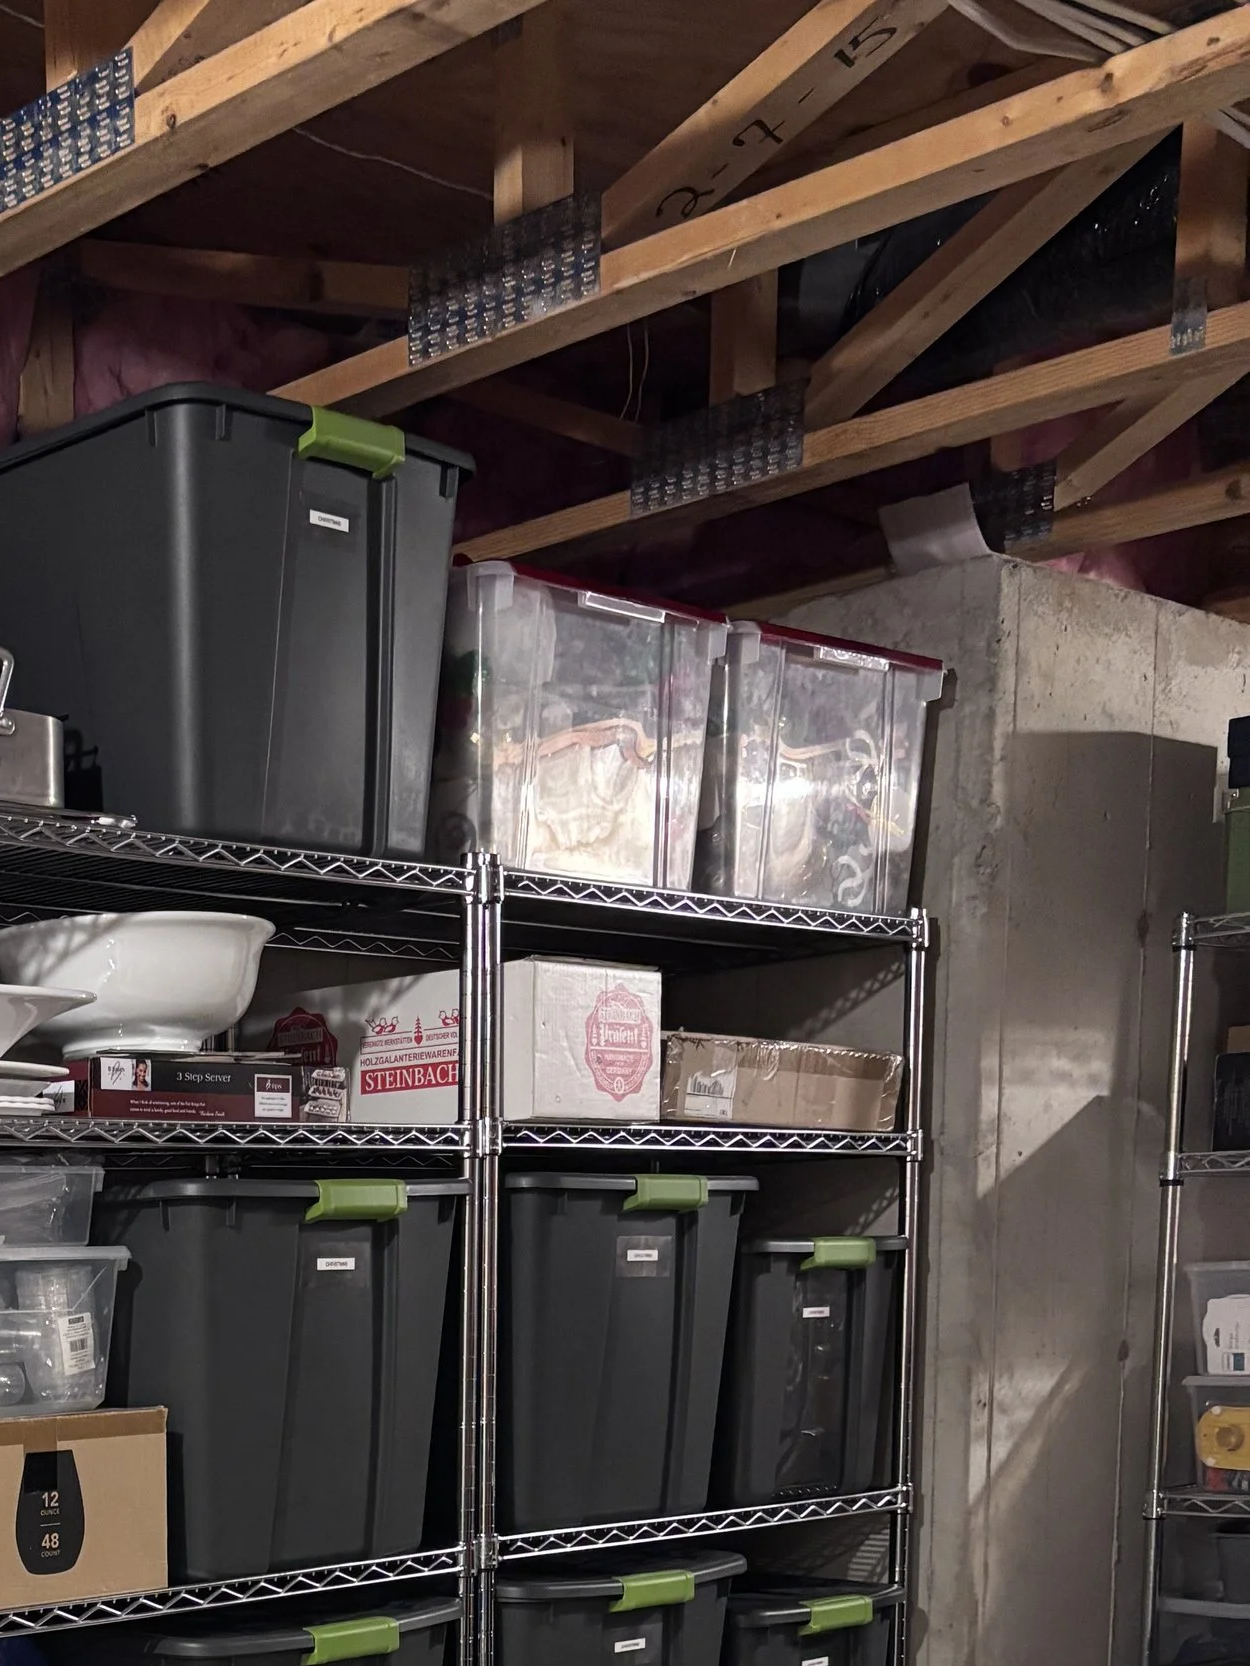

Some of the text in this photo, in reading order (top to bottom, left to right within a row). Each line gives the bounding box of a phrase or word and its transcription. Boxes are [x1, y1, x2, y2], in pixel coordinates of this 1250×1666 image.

[360, 1048, 459, 1067] HOLZGALANTERIEWARENF
[176, 1072, 231, 1083] 3 Step Server
[365, 1063, 459, 1091] STEINBACH
[41, 1491, 59, 1508] 12
[40, 1508, 60, 1517] OUNCE
[41, 1533, 60, 1550] 48
[40, 1549, 61, 1559] COUNT
